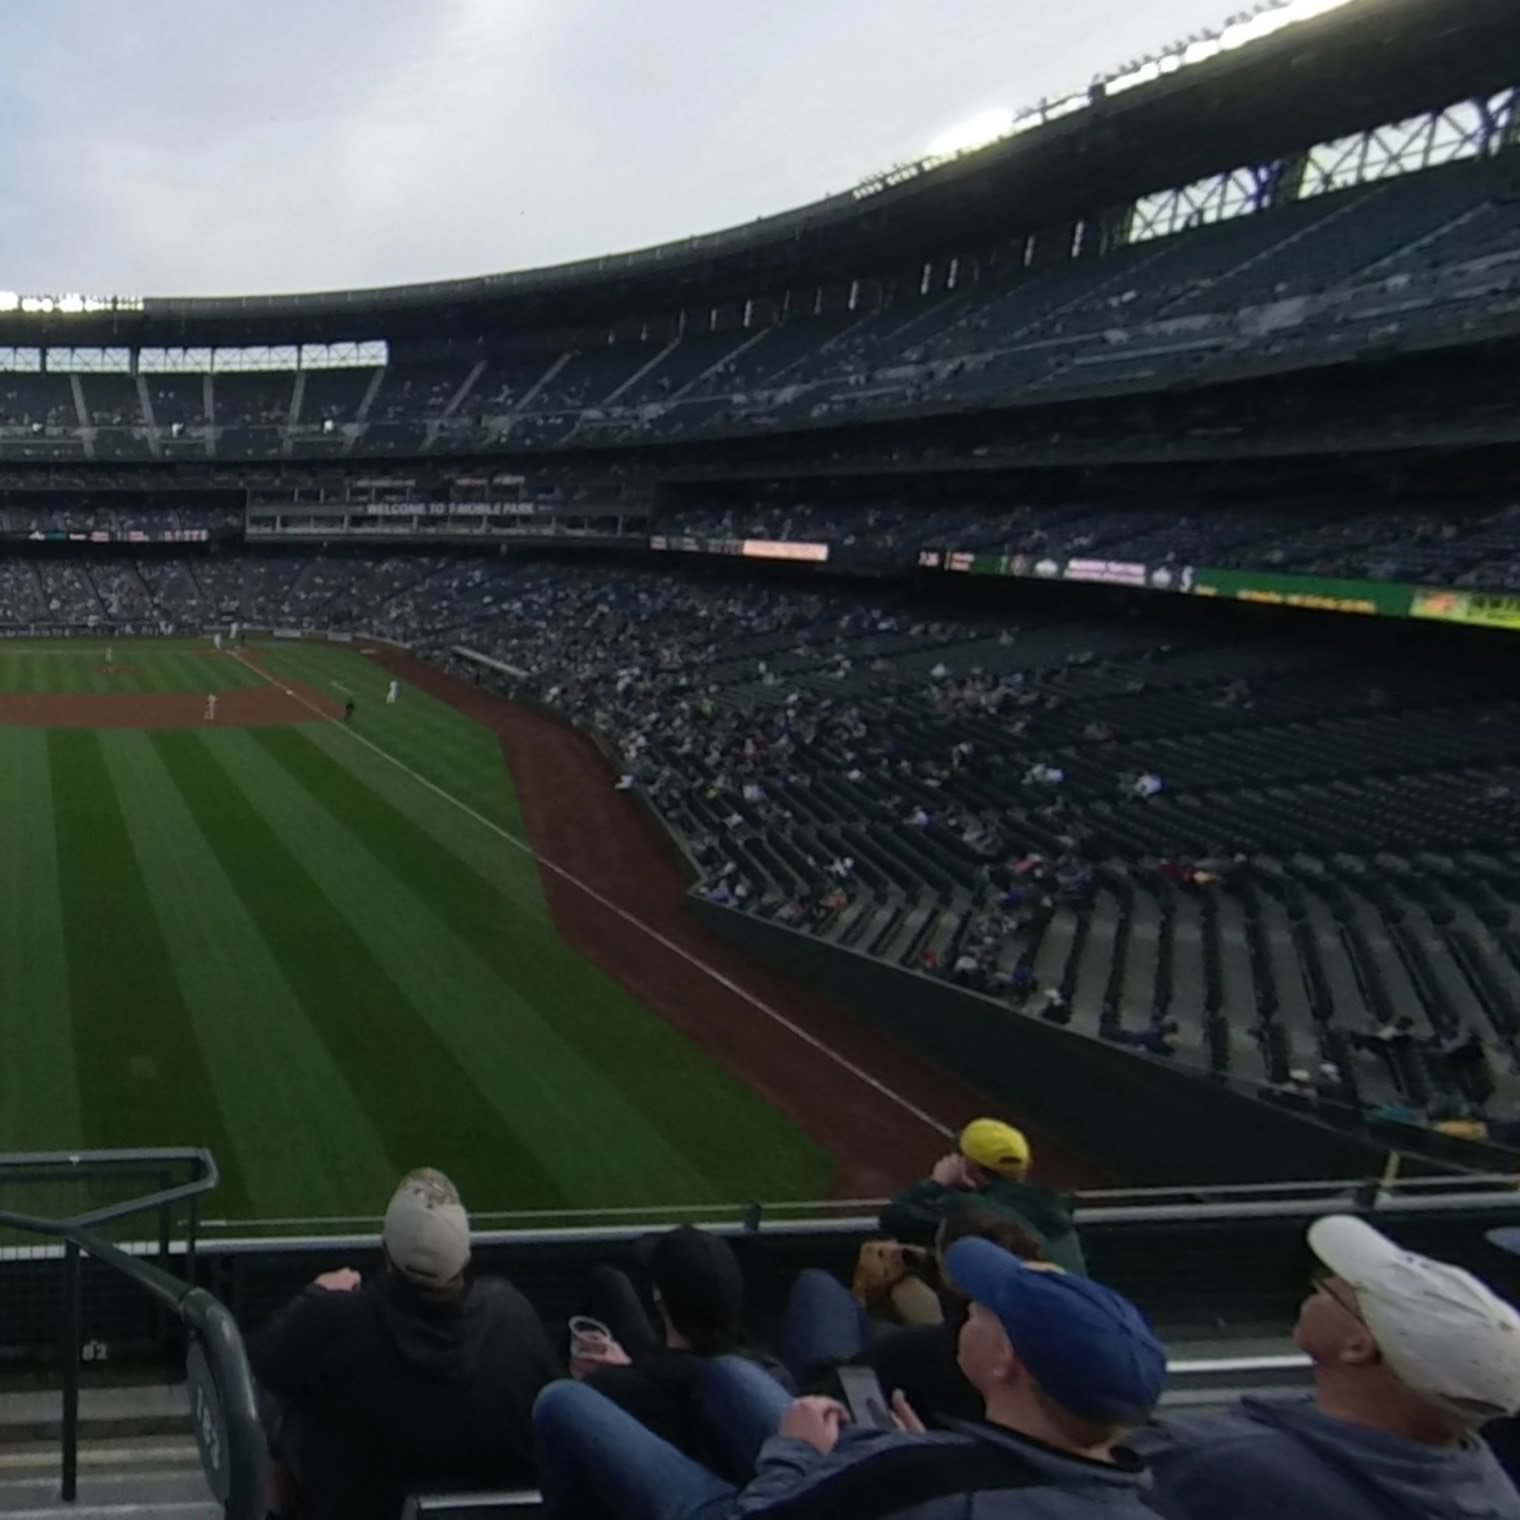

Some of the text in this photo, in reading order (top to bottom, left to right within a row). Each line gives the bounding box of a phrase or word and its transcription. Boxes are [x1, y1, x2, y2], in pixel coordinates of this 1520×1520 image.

[367, 503, 426, 515] WELCOME
[429, 503, 445, 515] TO
[503, 502, 534, 514] PARK
